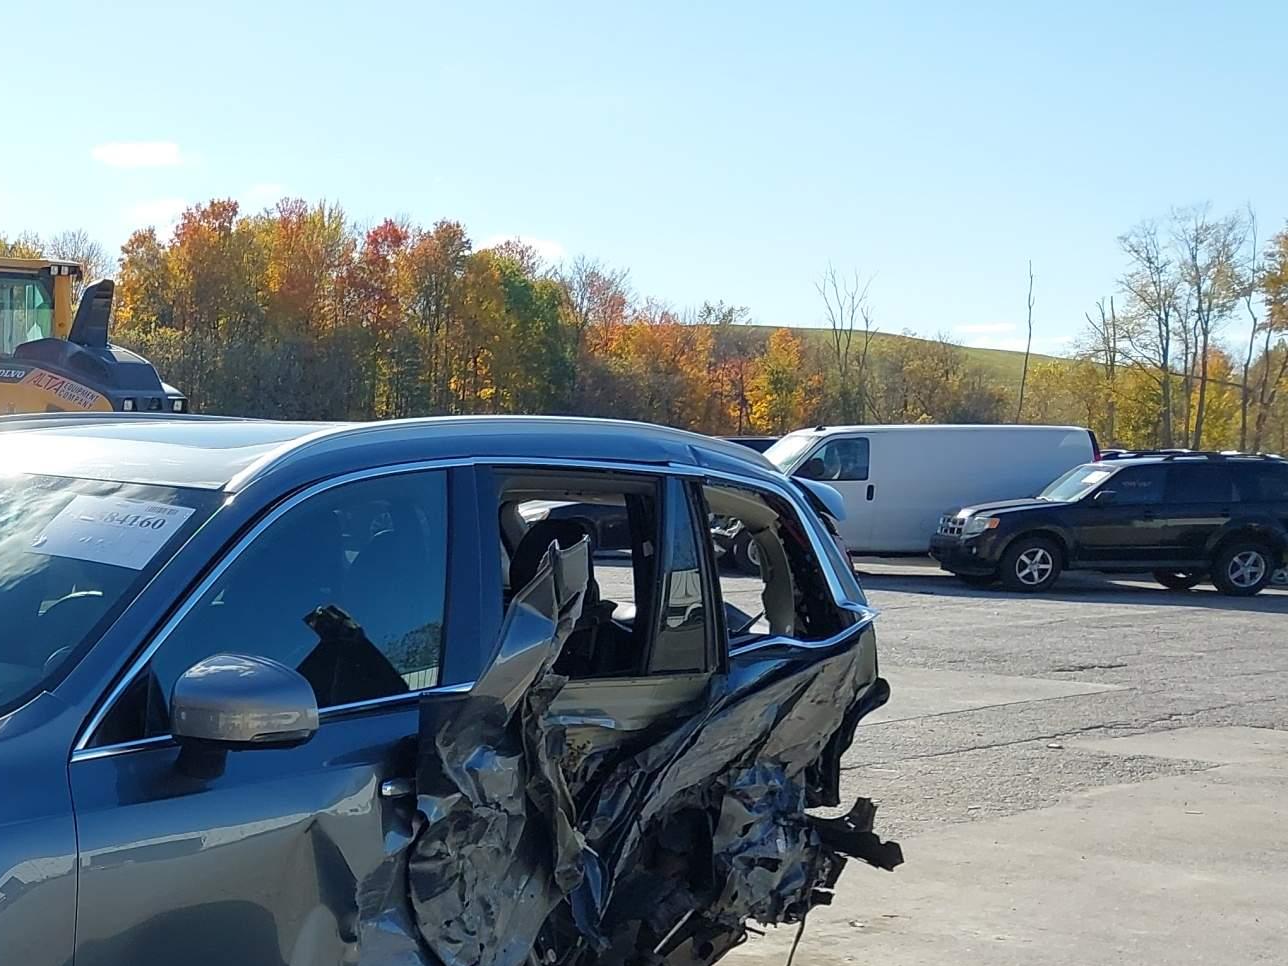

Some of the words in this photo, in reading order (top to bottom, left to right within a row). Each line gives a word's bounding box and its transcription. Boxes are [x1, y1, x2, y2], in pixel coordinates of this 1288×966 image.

[27, 372, 64, 395] ALTA
[64, 382, 99, 402] EQUIPMENT
[59, 391, 93, 409] COMPANY
